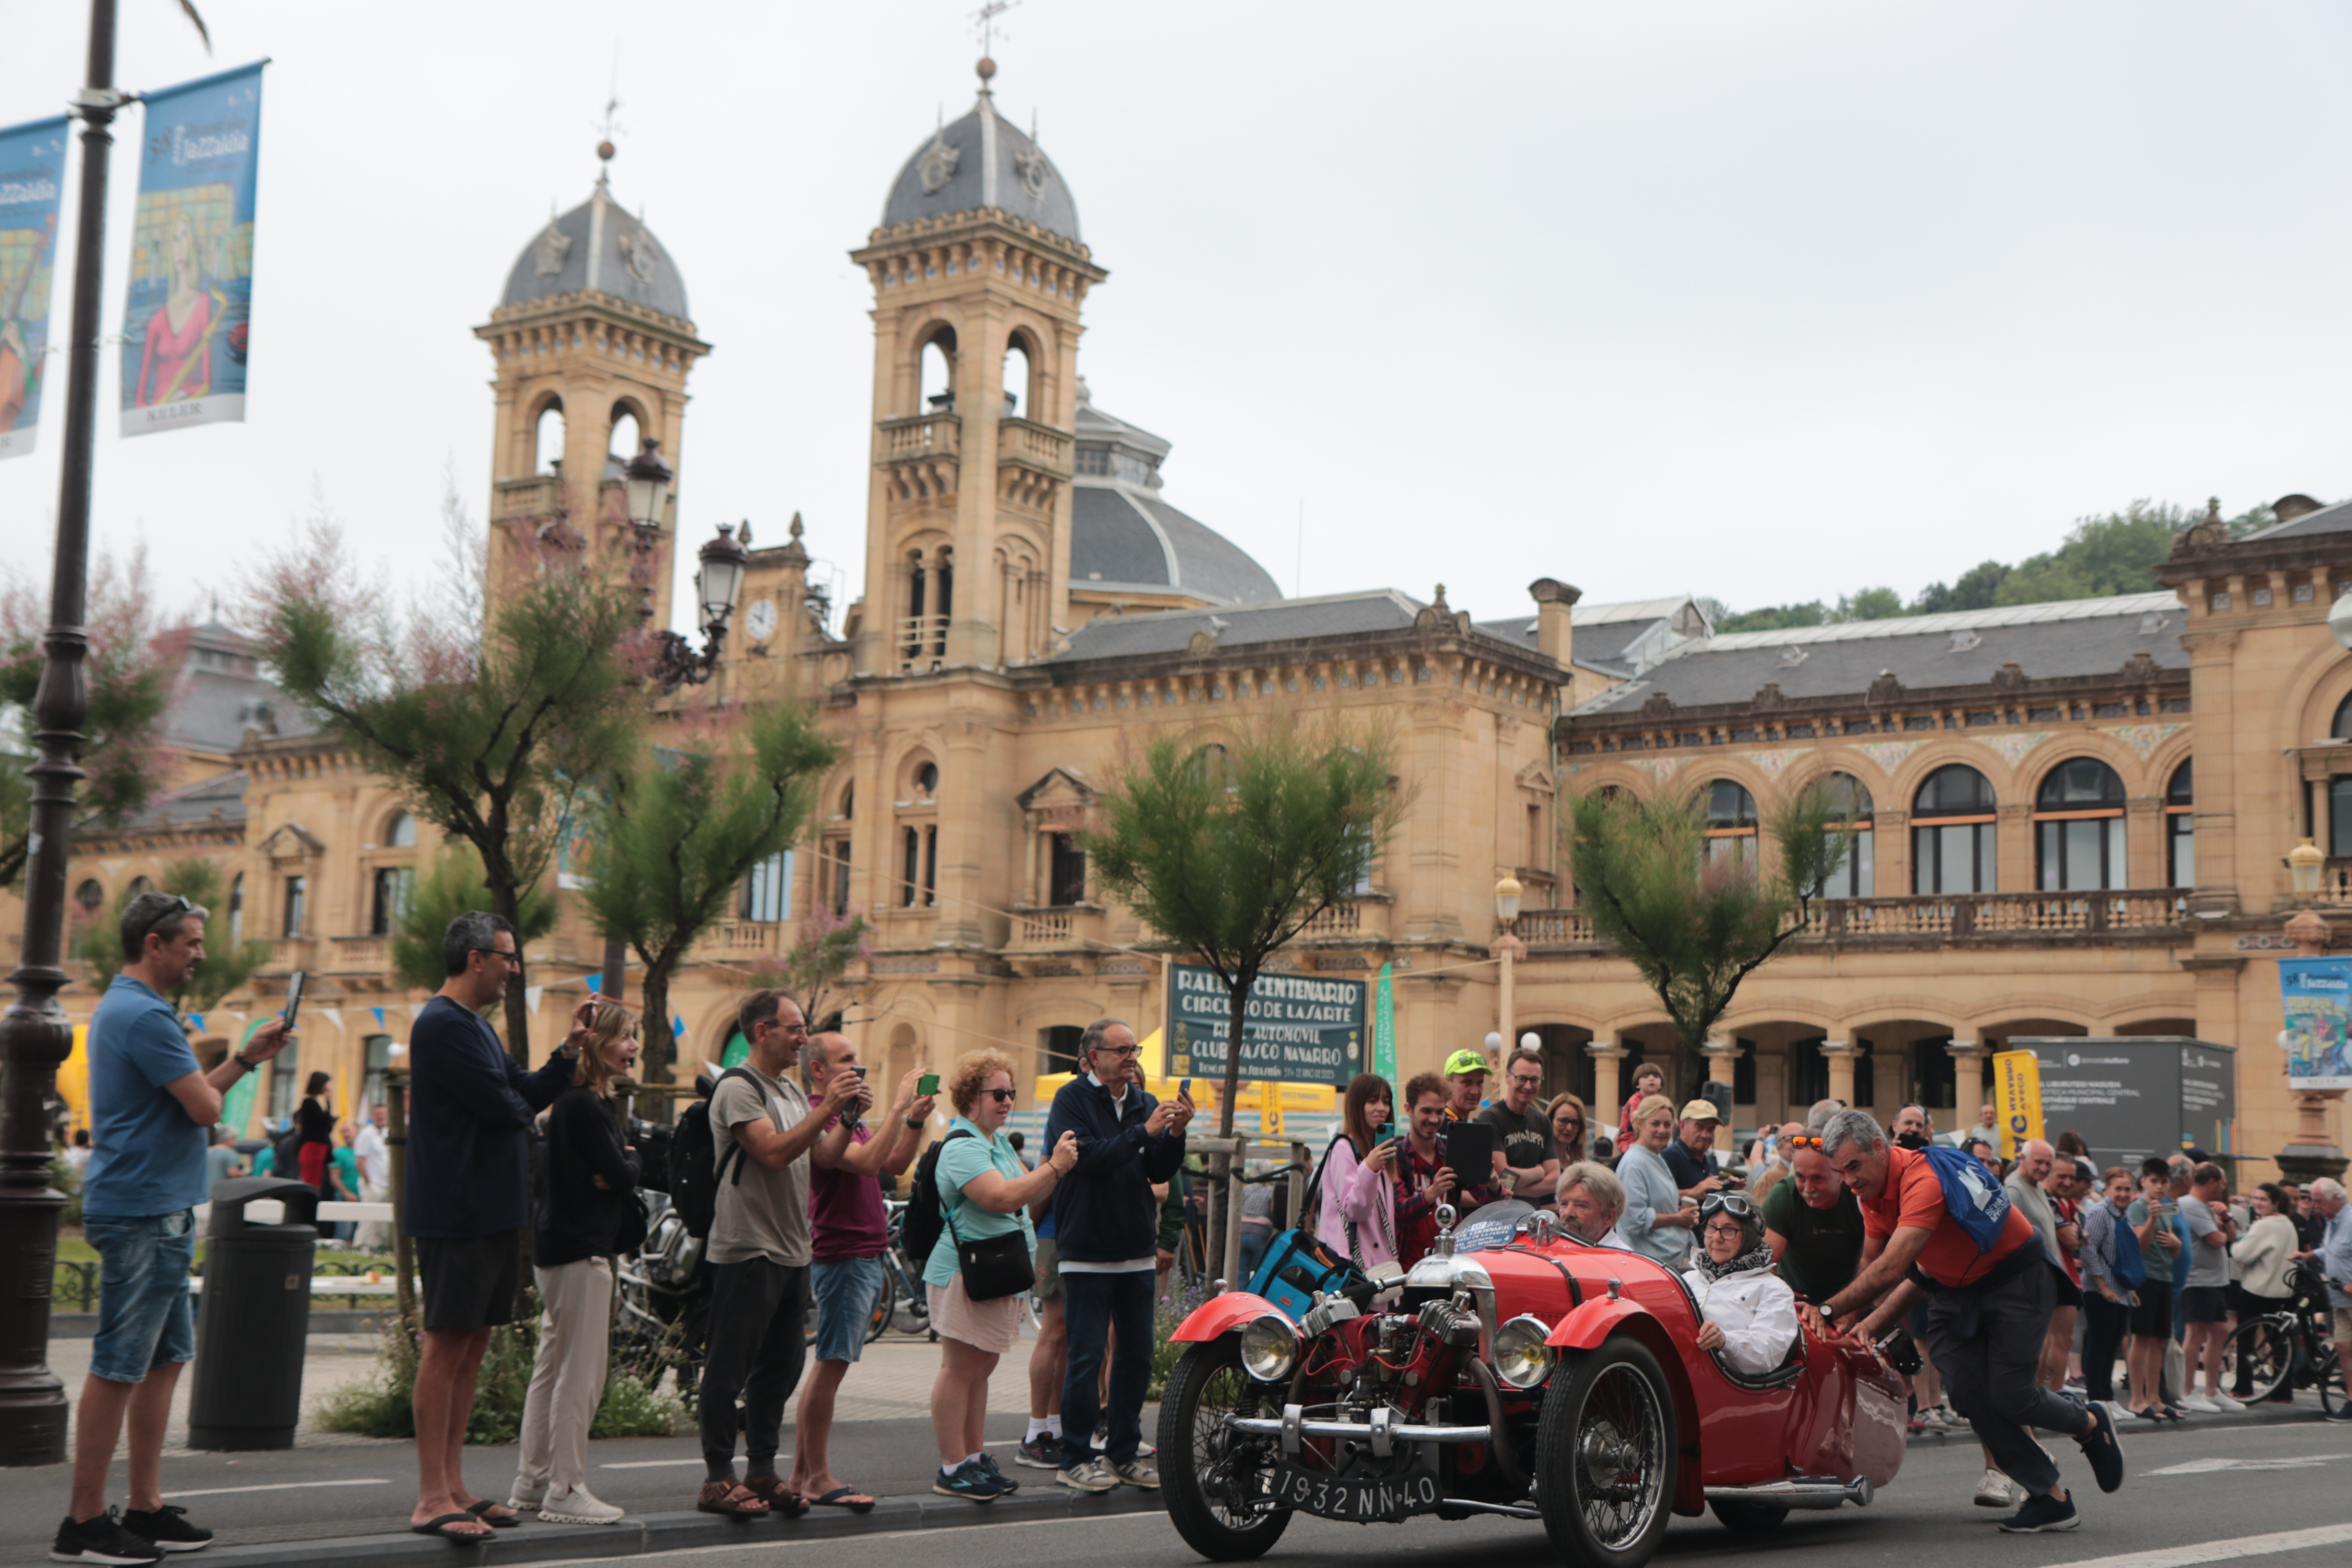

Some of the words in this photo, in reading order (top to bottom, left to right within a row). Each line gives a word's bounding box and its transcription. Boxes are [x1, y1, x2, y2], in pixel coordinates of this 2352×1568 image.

[1254, 975, 1357, 1005] CENTENARIO
[1182, 995, 1261, 1018] CIRCUTO
[1263, 1001, 1282, 1018] DE
[1287, 1004, 1352, 1022] LASARTE
[1253, 1026, 1321, 1045] AUTOMOVIL
[1192, 1039, 1227, 1060] CLUB
[1284, 1045, 1341, 1066] NAVARRO
[1469, 1224, 1512, 1236] CENTENARIO
[1280, 1470, 1347, 1514] 1932
[1404, 1477, 1435, 1508] 40
